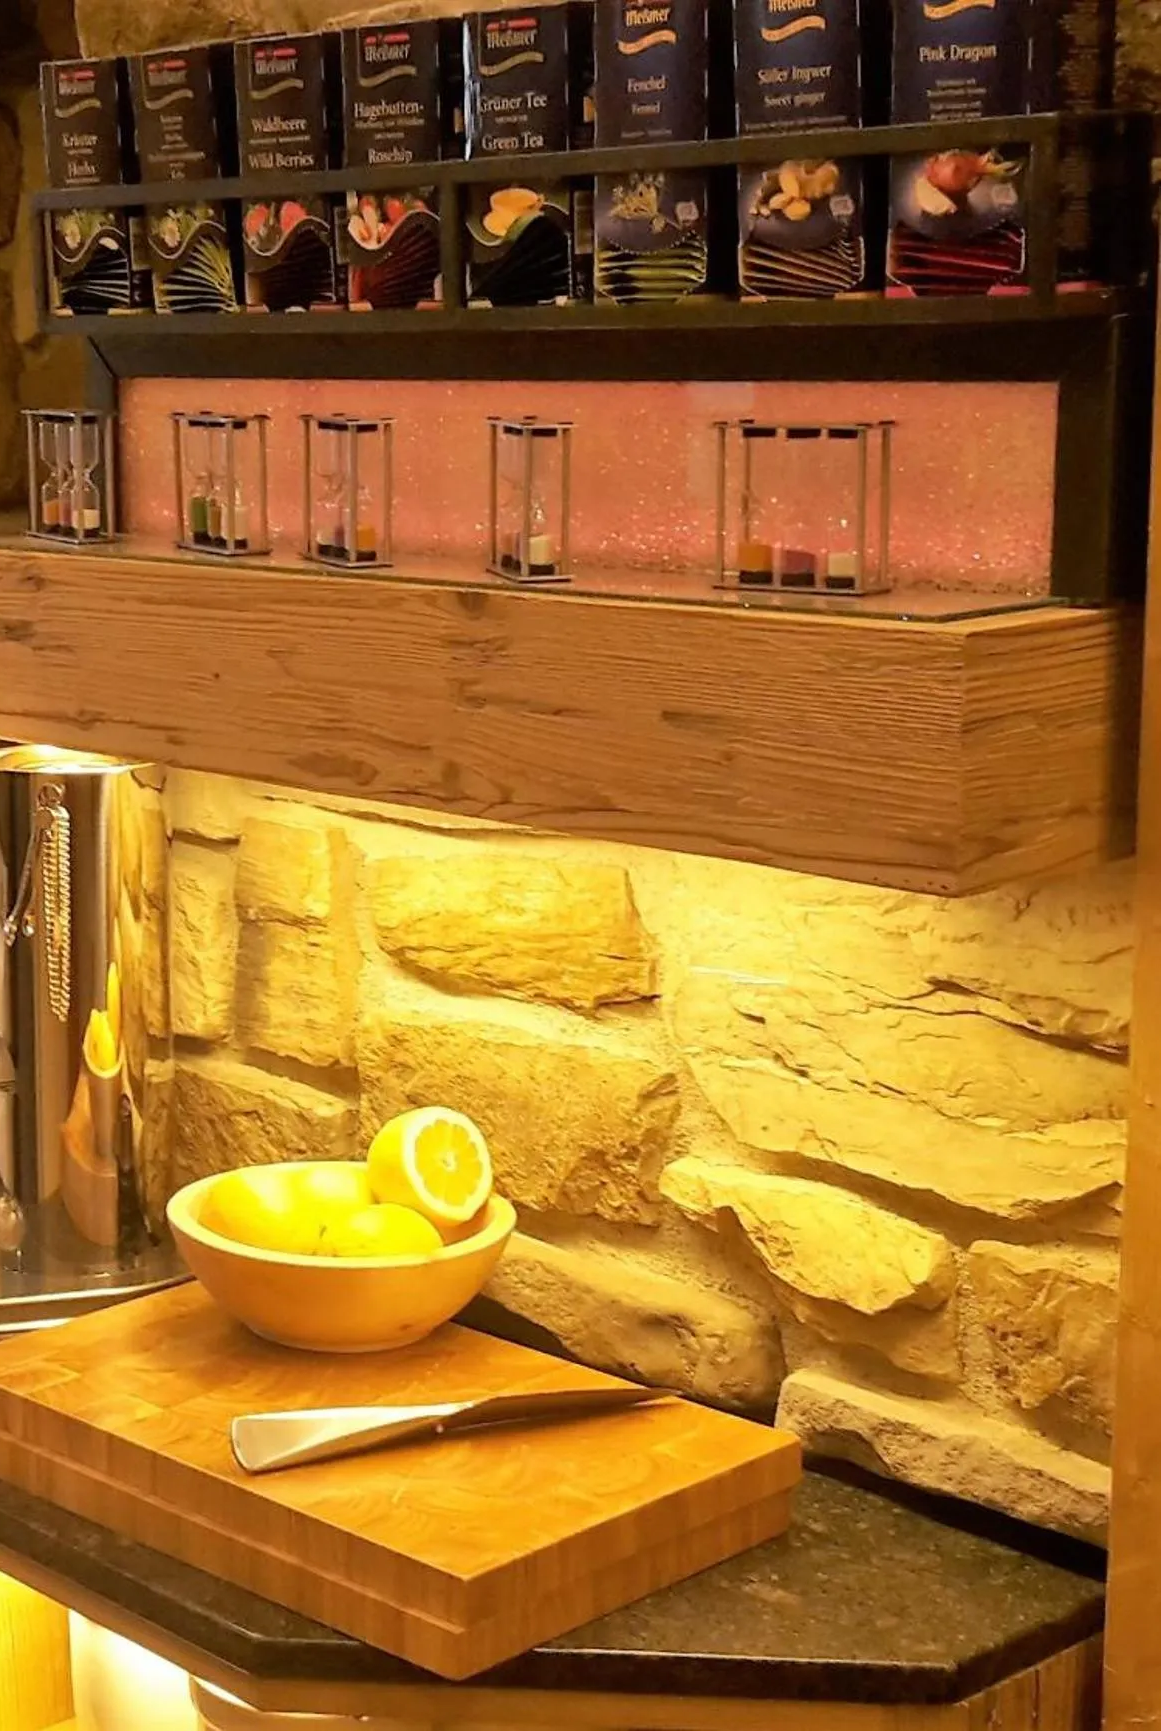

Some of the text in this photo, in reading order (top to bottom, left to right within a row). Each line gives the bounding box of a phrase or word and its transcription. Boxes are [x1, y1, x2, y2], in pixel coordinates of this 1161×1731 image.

[919, 44, 997, 62] Pink Dragon
[792, 65, 832, 83] Ingwer
[627, 75, 666, 93] Fenchel
[525, 91, 548, 109] Tee
[482, 132, 545, 151] Green Tea
[249, 151, 315, 169] Wild Berries
[368, 146, 414, 165] Rosehip
